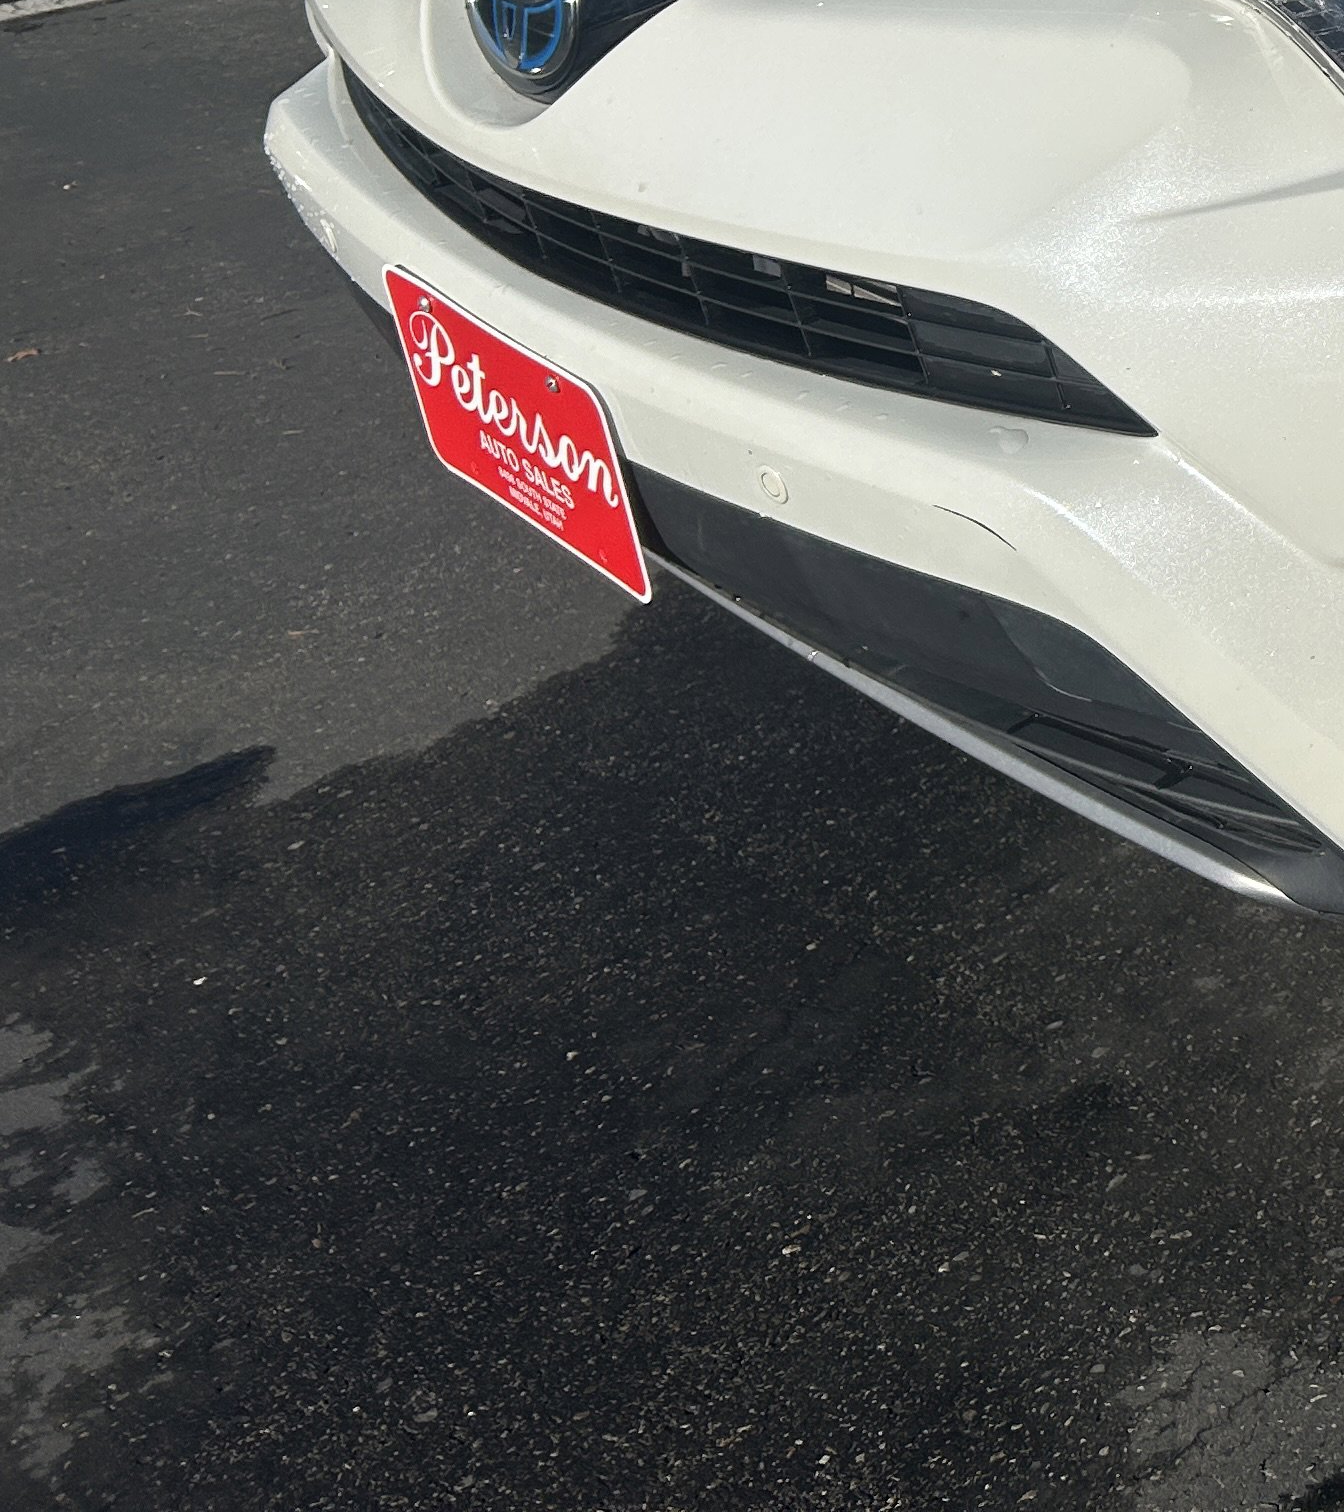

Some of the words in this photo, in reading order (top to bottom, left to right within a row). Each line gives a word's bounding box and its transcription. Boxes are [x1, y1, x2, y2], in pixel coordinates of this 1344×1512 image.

[409, 311, 618, 507] Peterson
[480, 430, 520, 472] AUTO
[522, 459, 575, 509] SALES
